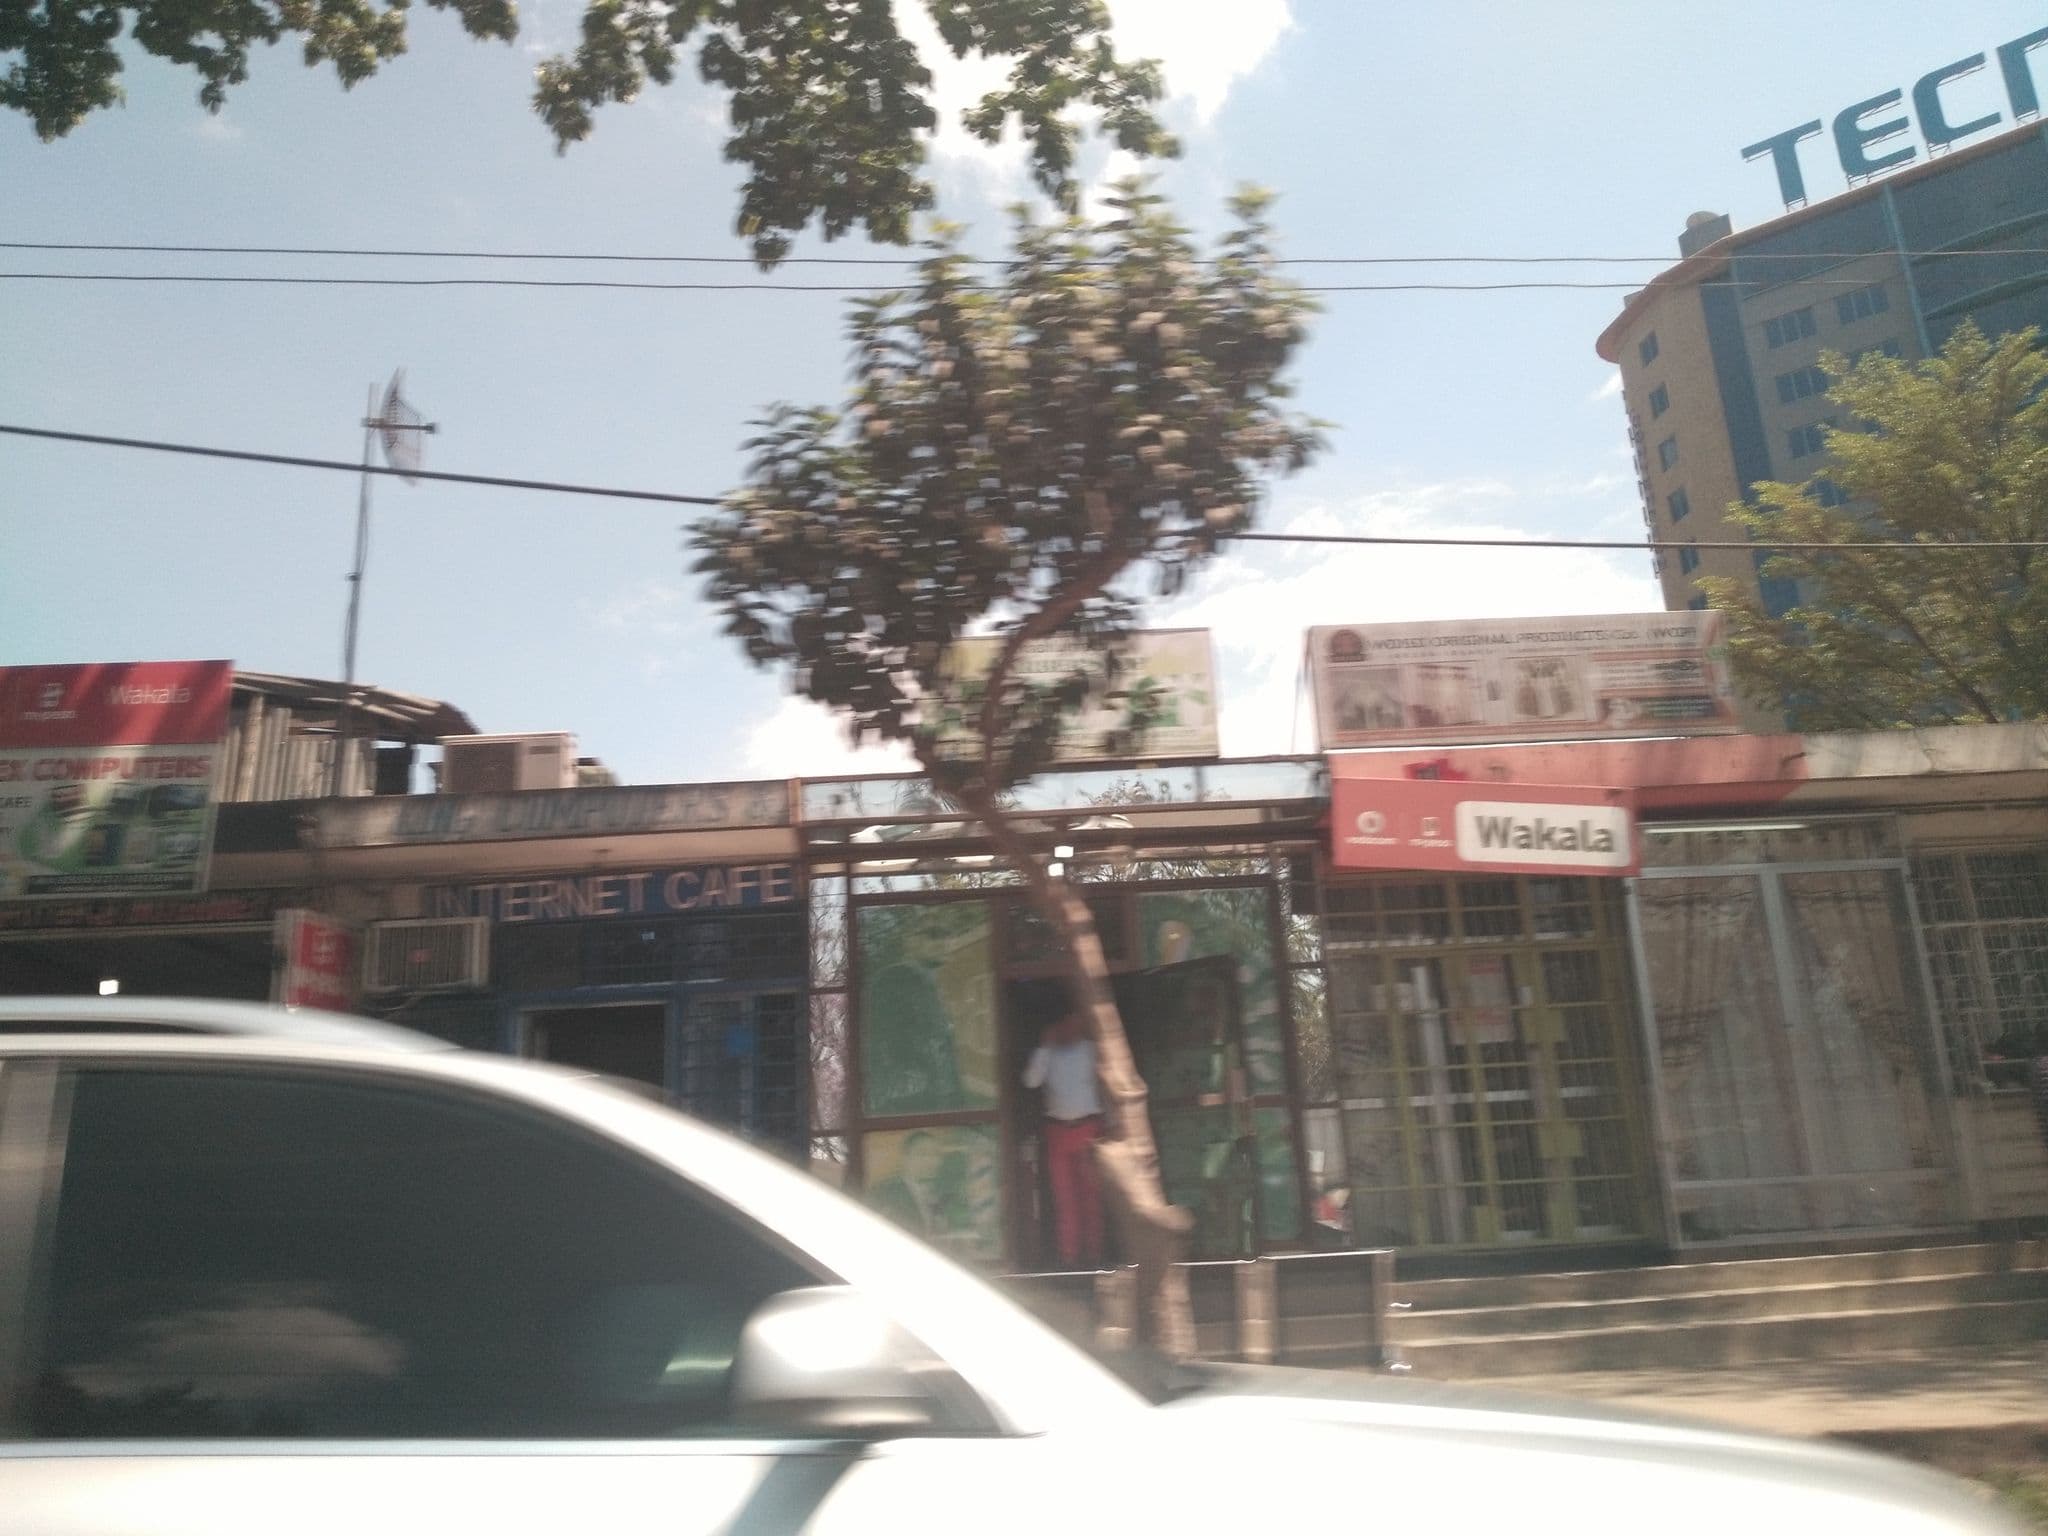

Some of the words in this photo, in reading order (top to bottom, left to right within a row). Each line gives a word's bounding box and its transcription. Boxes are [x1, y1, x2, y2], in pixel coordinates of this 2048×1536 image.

[33, 755, 210, 780] COMPUTERS
[1473, 814, 1617, 853] Wakala
[434, 870, 653, 923] INTERNET
[664, 862, 793, 910] CAFE
